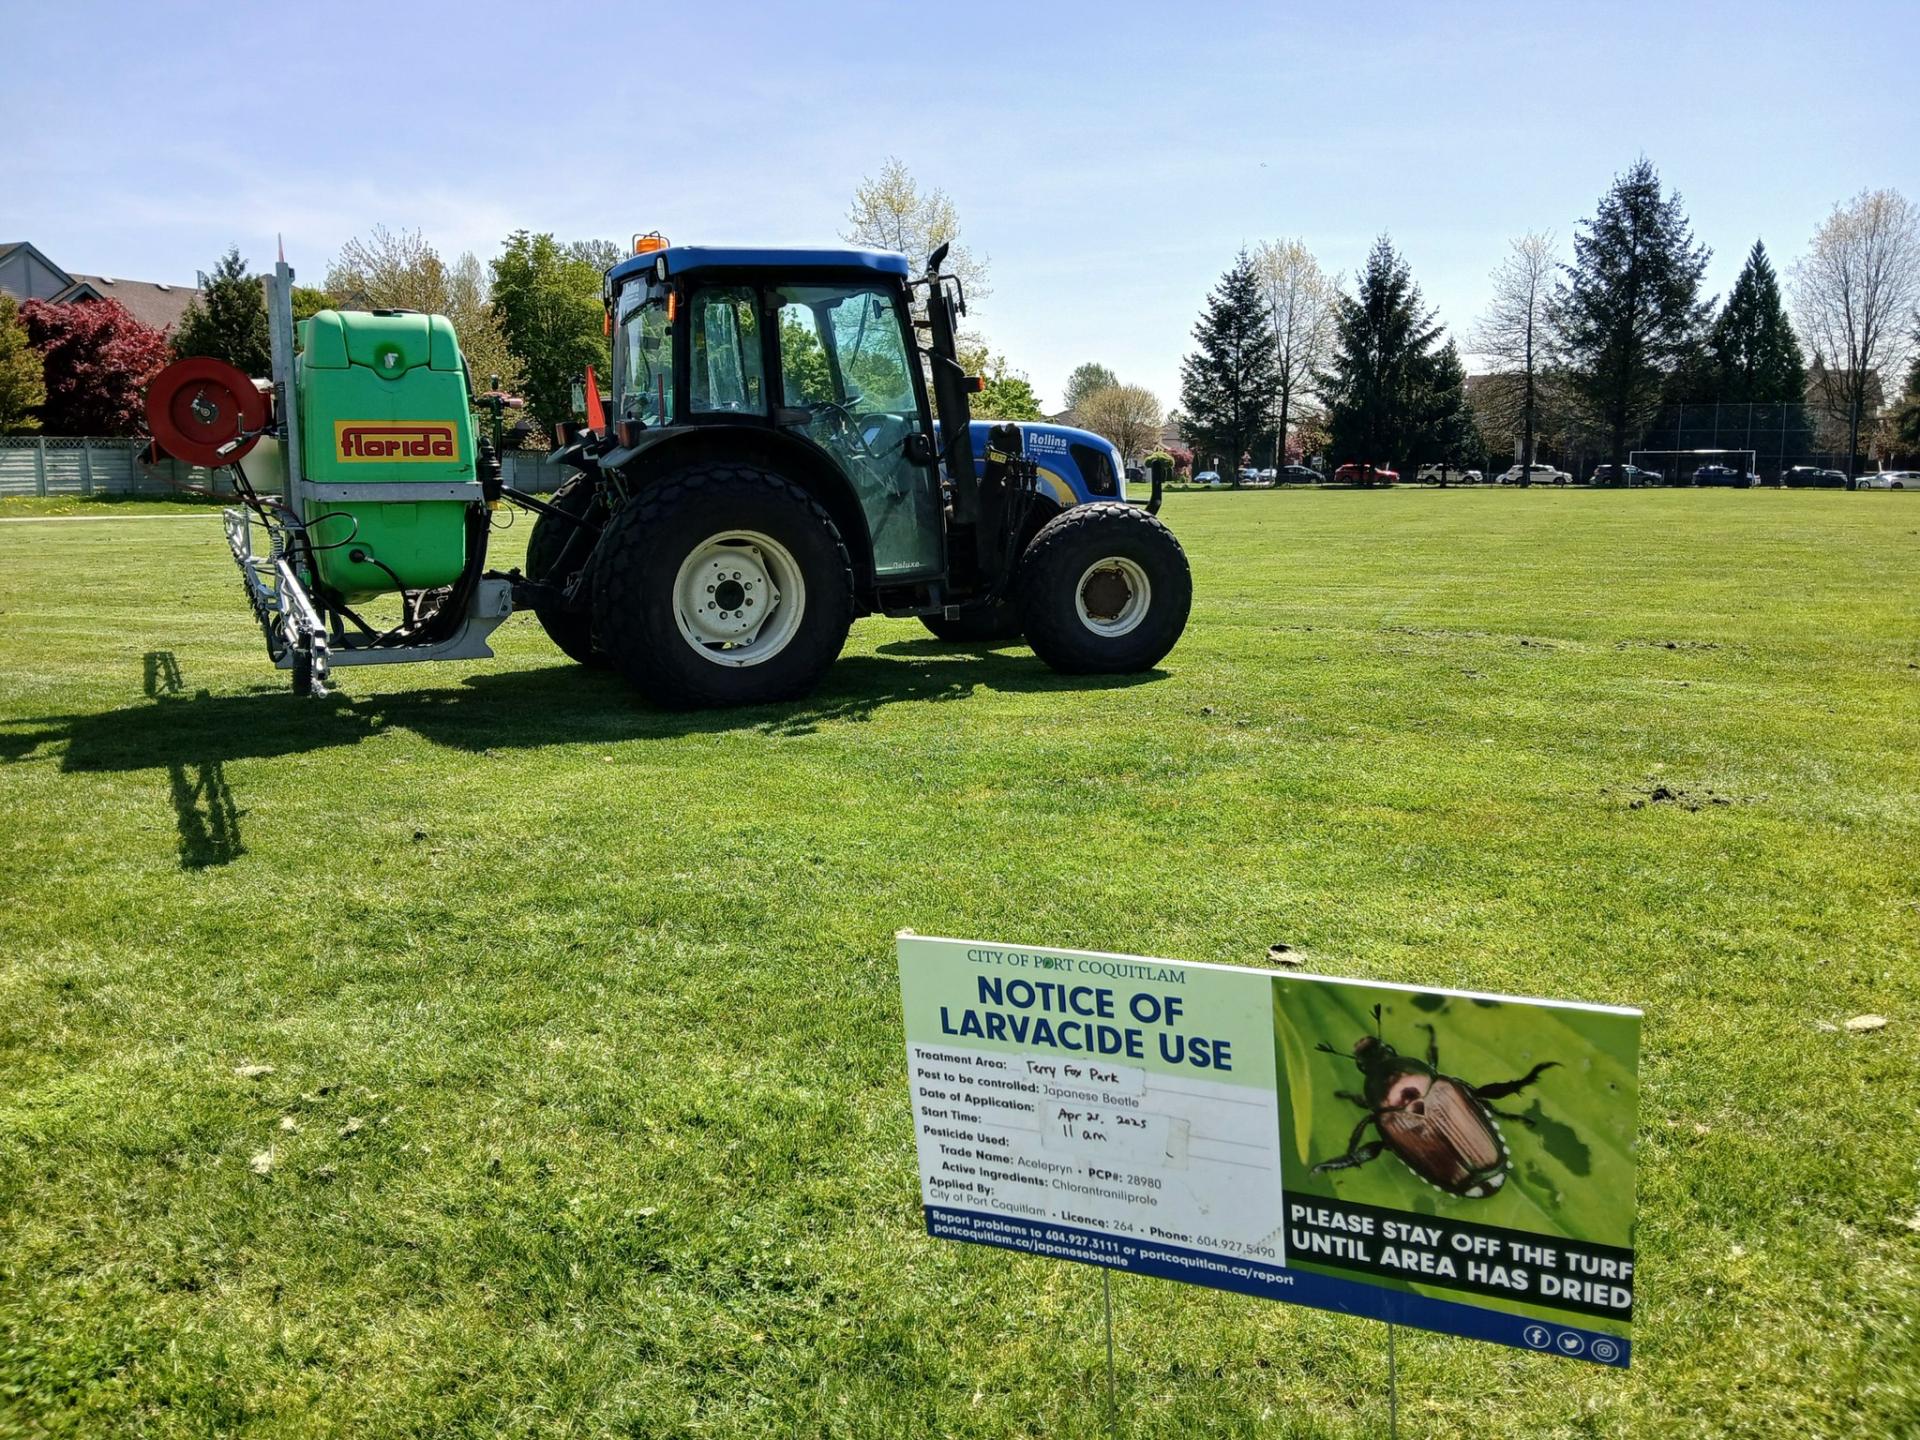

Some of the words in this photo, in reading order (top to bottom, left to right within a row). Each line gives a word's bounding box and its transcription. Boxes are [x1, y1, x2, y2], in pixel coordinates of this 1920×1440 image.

[341, 427, 453, 457] florida
[1030, 432, 1067, 447] Rollins
[967, 949, 1003, 964] CITY
[1007, 953, 1029, 966] OF
[1034, 955, 1074, 971] PORT
[1078, 960, 1186, 984] COQUITLAM
[977, 975, 1115, 1019] NOTICE
[1129, 993, 1183, 1026] OF
[940, 1007, 1144, 1059] LARVACIDE
[1159, 1033, 1232, 1071] USE
[915, 1048, 972, 1065] Treatment
[976, 1057, 1007, 1069] Area:
[1026, 1061, 1056, 1078] Terry
[1064, 1065, 1082, 1078] Fox
[1089, 1068, 1120, 1083] Park
[917, 1068, 940, 1080] Pest
[944, 1073, 955, 1082] to
[959, 1073, 974, 1085] be
[978, 1077, 1040, 1093] controlled:
[1043, 1084, 1099, 1102] Japanese
[1102, 1093, 1139, 1108] Beetle
[919, 1087, 946, 1100] Date
[950, 1092, 961, 1101] of
[964, 1094, 1035, 1112] Application:
[921, 1106, 948, 1119] Start
[951, 1110, 982, 1124] Time:
[1057, 1108, 1082, 1123] Apr
[1116, 1115, 1147, 1129] 2025
[923, 1125, 974, 1141] Pesticide
[977, 1133, 1010, 1147] Used:
[1063, 1124, 1073, 1138] 11
[1082, 1130, 1107, 1142] am
[940, 1144, 972, 1158] Trade
[976, 1150, 1014, 1165] Name:
[1088, 1167, 1123, 1183] PCP#:
[1127, 1175, 1162, 1190] 28980
[942, 1161, 976, 1175] Active
[979, 1167, 1049, 1187] Ingredients:
[1052, 1178, 1158, 1206] Chlorantraniliprole
[929, 1176, 974, 1191] Applied
[977, 1183, 995, 1196] By:
[930, 1188, 950, 1201] City
[953, 1193, 963, 1202] of
[966, 1194, 988, 1206] Port
[991, 1198, 1046, 1217] Coquitlam
[1113, 1220, 1133, 1232] 264
[1150, 1226, 1192, 1243] Phone:
[932, 1210, 970, 1225] Report
[974, 1218, 1027, 1235] problems
[1030, 1228, 1042, 1238] to
[1045, 1230, 1119, 1252] 604.927.3111
[1123, 1246, 1136, 1255] or
[1139, 1249, 1294, 1285] portcoquitlam.ca/report
[934, 1224, 1128, 1266] portcoquitlam.ca/japanesebeetle
[1291, 1204, 1374, 1235] PLEASE
[1382, 1221, 1443, 1246] STAY
[1451, 1233, 1500, 1257] OFF
[1509, 1242, 1556, 1268] THE
[1566, 1252, 1633, 1280] TURF
[1291, 1229, 1371, 1262] UNTIL
[1380, 1246, 1457, 1278] AREA
[1467, 1260, 1529, 1290] HAS
[1540, 1273, 1632, 1309] DRIED
